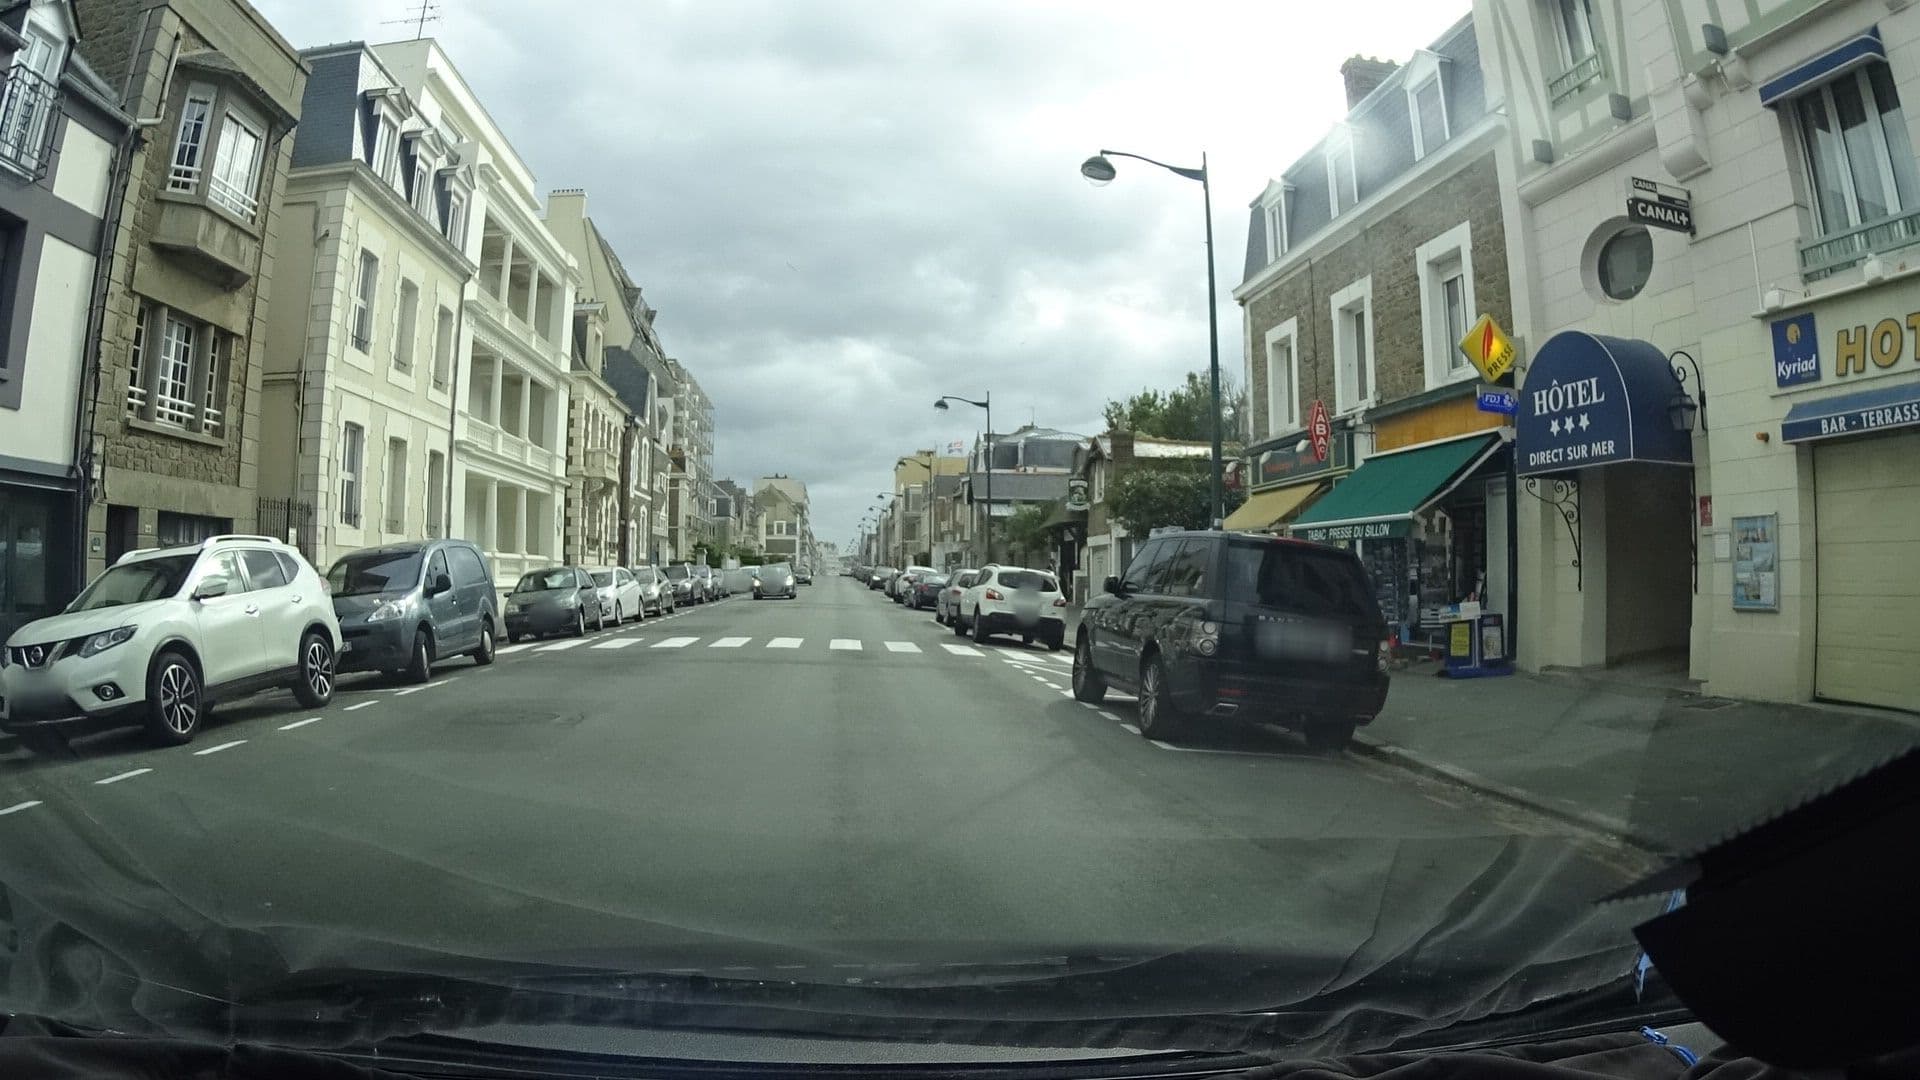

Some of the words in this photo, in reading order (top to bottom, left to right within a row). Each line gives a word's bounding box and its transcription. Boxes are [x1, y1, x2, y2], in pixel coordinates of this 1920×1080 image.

[1637, 202, 1689, 226] CANAL+
[1777, 353, 1816, 380] Kyriad
[1484, 393, 1501, 404] FDJ
[1533, 377, 1605, 416] HÔTEL
[1315, 406, 1327, 454] TABAC
[1821, 417, 1846, 434] BAR
[1861, 403, 1920, 428] TERRASS
[1529, 447, 1563, 467] DIRECT
[1566, 444, 1588, 460] SUR
[1591, 440, 1615, 456] MER
[1308, 529, 1327, 541] TABAC
[1329, 526, 1353, 539] PRESSE
[1353, 524, 1364, 538] DU
[1365, 523, 1390, 537] SILLON
